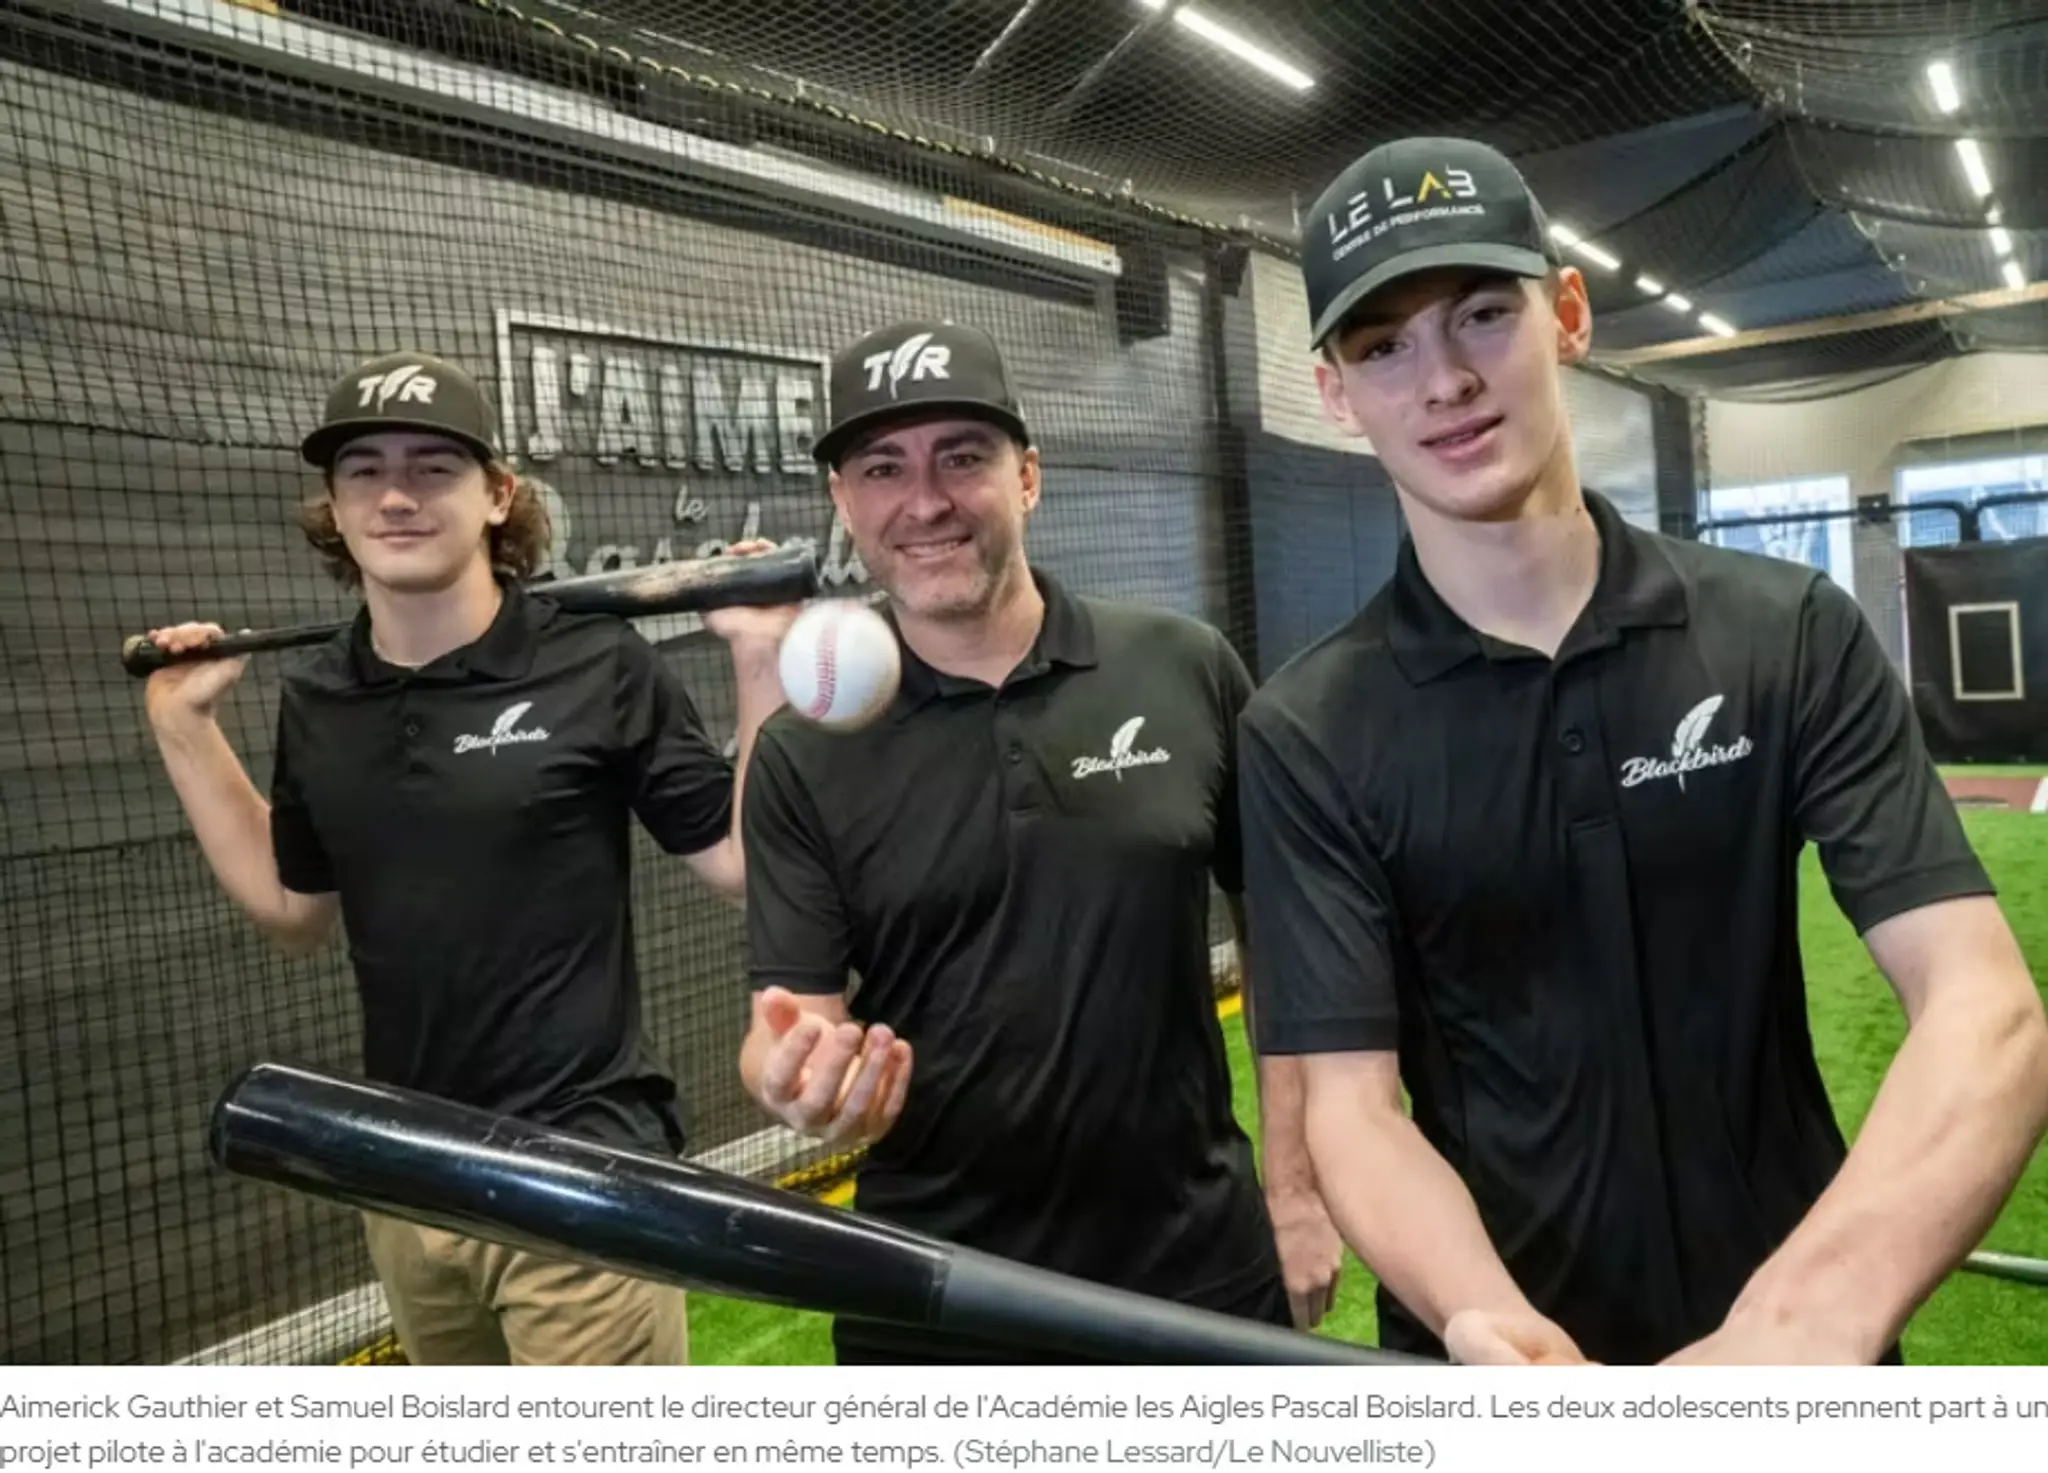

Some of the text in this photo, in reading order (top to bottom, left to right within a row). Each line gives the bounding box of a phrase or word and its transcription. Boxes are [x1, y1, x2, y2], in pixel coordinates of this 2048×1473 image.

[1328, 164, 1477, 245] LE LAB
[1620, 735, 1754, 788] Blackbirds
